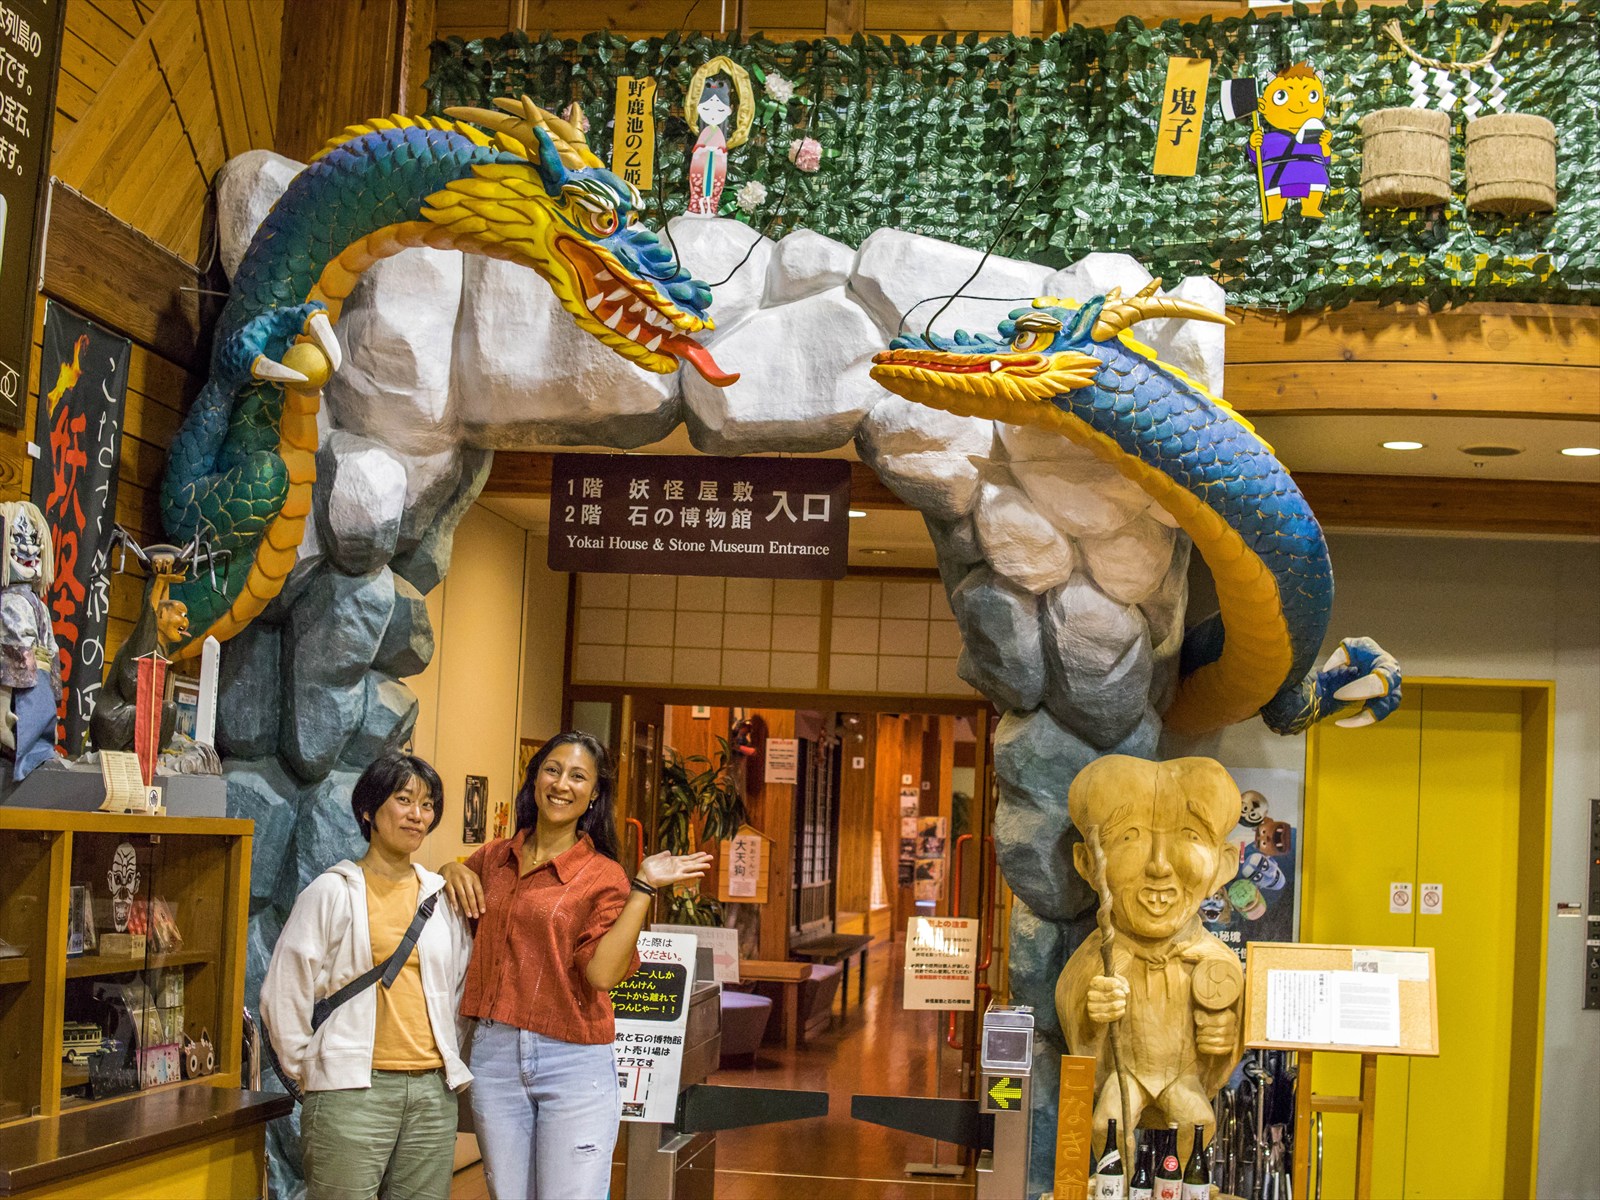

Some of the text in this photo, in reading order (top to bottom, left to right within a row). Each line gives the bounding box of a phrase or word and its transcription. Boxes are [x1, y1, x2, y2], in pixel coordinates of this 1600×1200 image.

[624, 80, 646, 185] 野鹿池の乙姫
[1164, 86, 1197, 147] 鬼子
[628, 478, 754, 503] 妖怪屋敷
[765, 490, 831, 524] 入口
[627, 505, 753, 530] 石の博物館
[566, 535, 830, 556] Yokai House & Stone Museum Entrance
[735, 840, 746, 877] 大天狗
